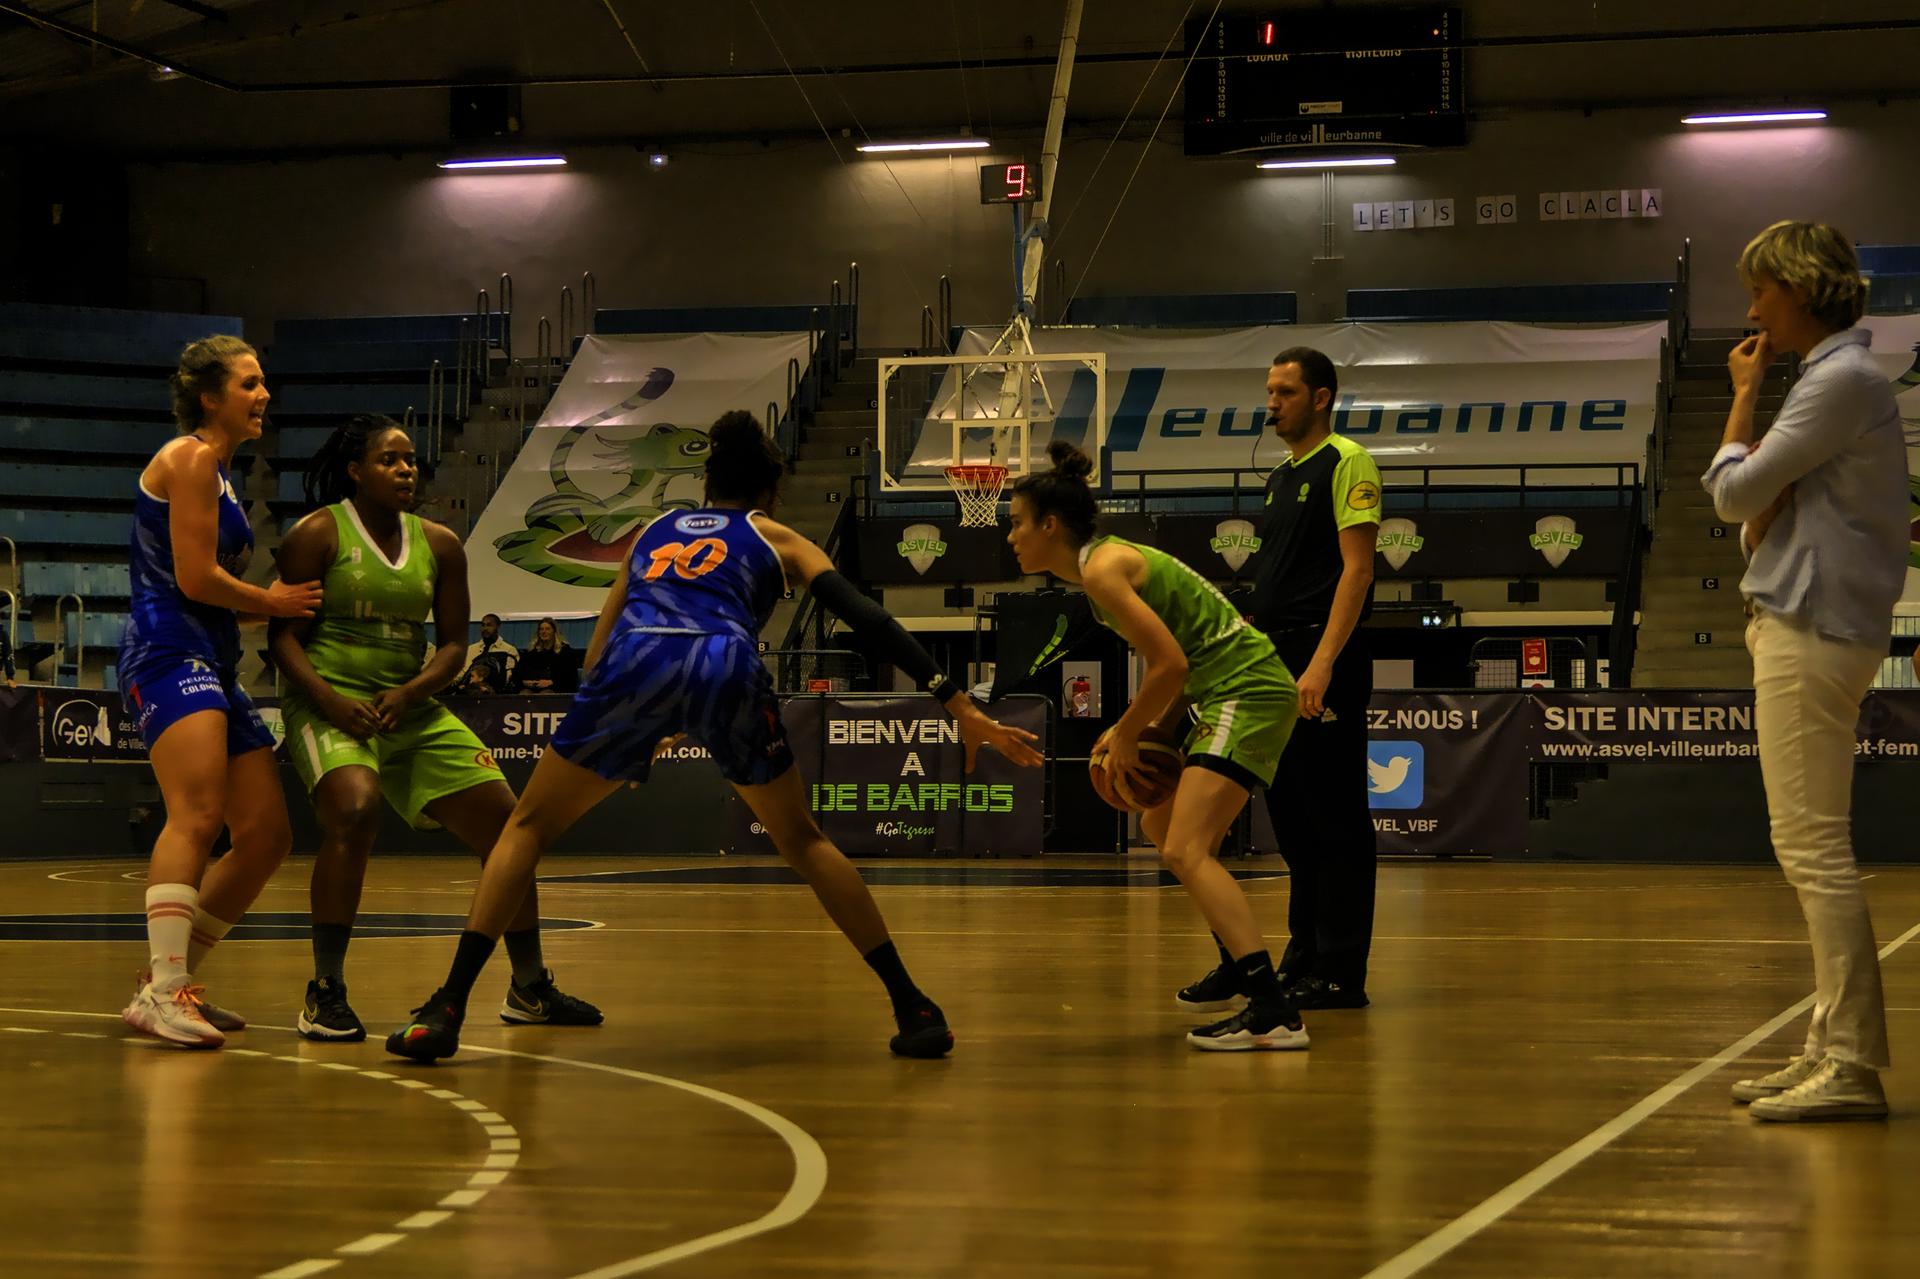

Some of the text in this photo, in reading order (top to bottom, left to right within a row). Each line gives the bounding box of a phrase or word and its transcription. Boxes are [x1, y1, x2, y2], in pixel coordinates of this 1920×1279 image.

[1260, 123, 1383, 145] ville de villeurbanne
[1006, 164, 1025, 197] 9
[1359, 196, 1659, 225] LET'S GO CLACLA
[1214, 534, 1258, 551] ASVEL
[1376, 533, 1420, 550] ASVEL
[1534, 531, 1579, 546] ASVEL
[1713, 528, 1723, 537] D
[902, 538, 943, 552] ASVEL
[643, 537, 729, 583] 10
[1705, 579, 1715, 588] C
[1698, 633, 1708, 643] B
[1544, 706, 1757, 731] SITE INTERN
[828, 719, 960, 745] BIENVEN
[900, 751, 926, 777] A
[811, 783, 858, 812] DE
